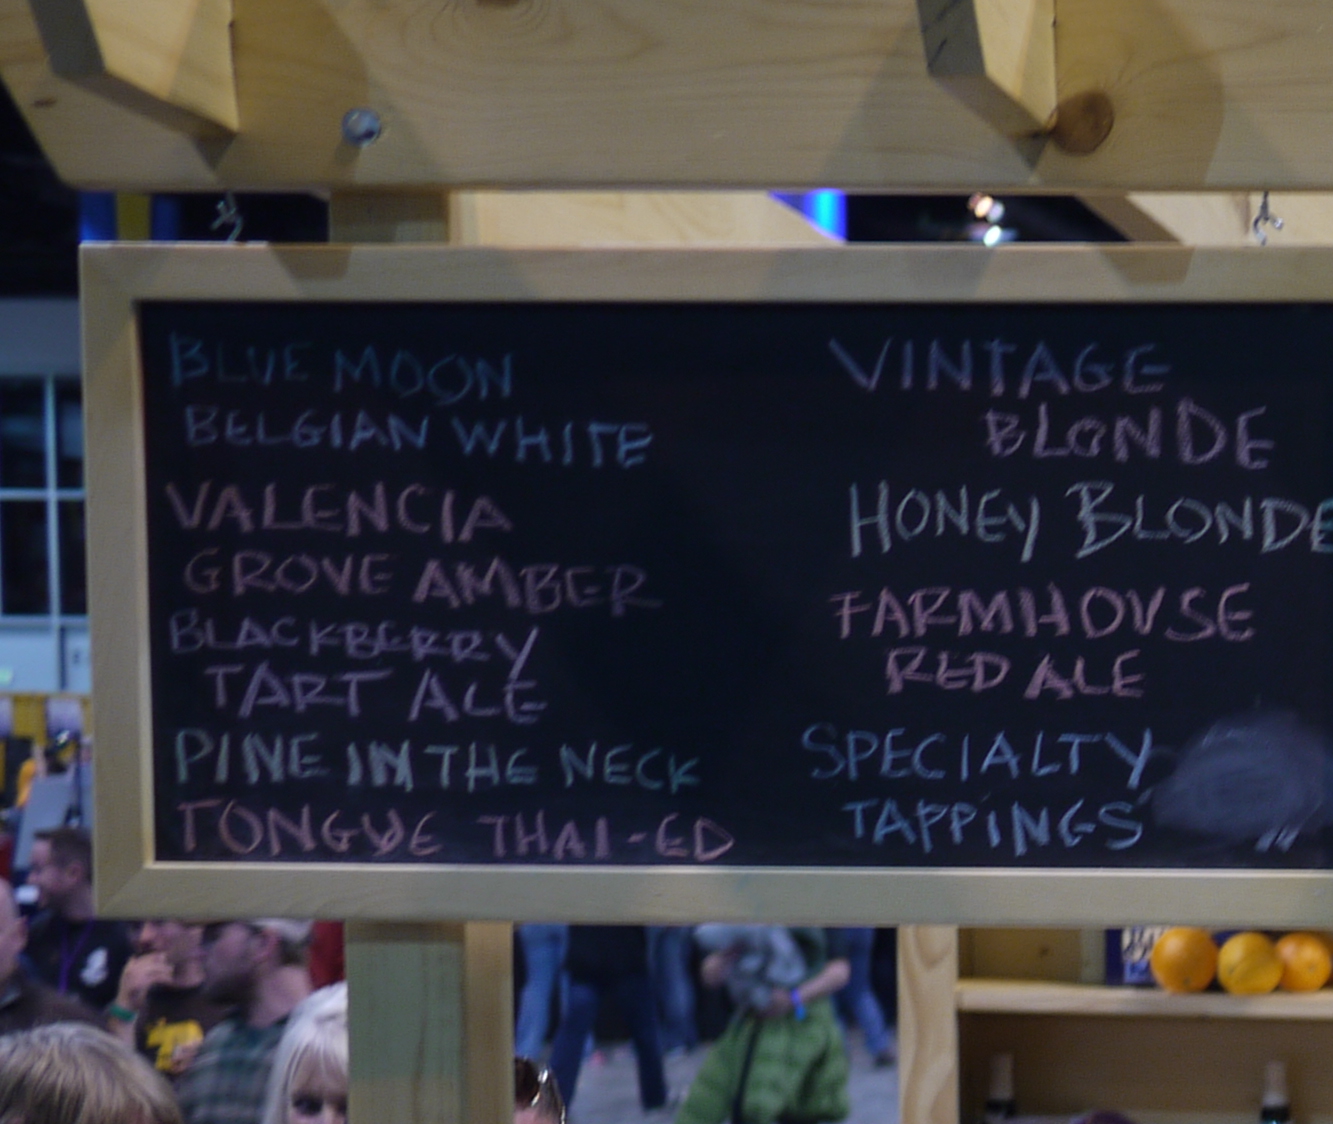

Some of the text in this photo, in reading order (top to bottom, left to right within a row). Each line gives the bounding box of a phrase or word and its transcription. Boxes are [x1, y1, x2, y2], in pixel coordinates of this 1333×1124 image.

[170, 330, 515, 404] BLUE MOON
[829, 337, 1171, 398] VINTAGE
[184, 405, 653, 467] BELGIAN WHITE
[985, 397, 1275, 469] BLONDE
[166, 482, 512, 542] VALENCIA
[849, 480, 1040, 562] HONEY
[184, 549, 662, 616] GROVE AMBER
[830, 583, 1255, 643] FARMHOUSE
[169, 609, 538, 683] BLACKBERRY
[886, 647, 1145, 699] RED ALE
[206, 661, 546, 724] TART ALE
[176, 728, 700, 793] PINE IN THE NECK
[802, 723, 1153, 789] SPECIALTY
[177, 800, 733, 862] TONGUE THAI-ED
[843, 799, 1143, 855] TAPPINGS
